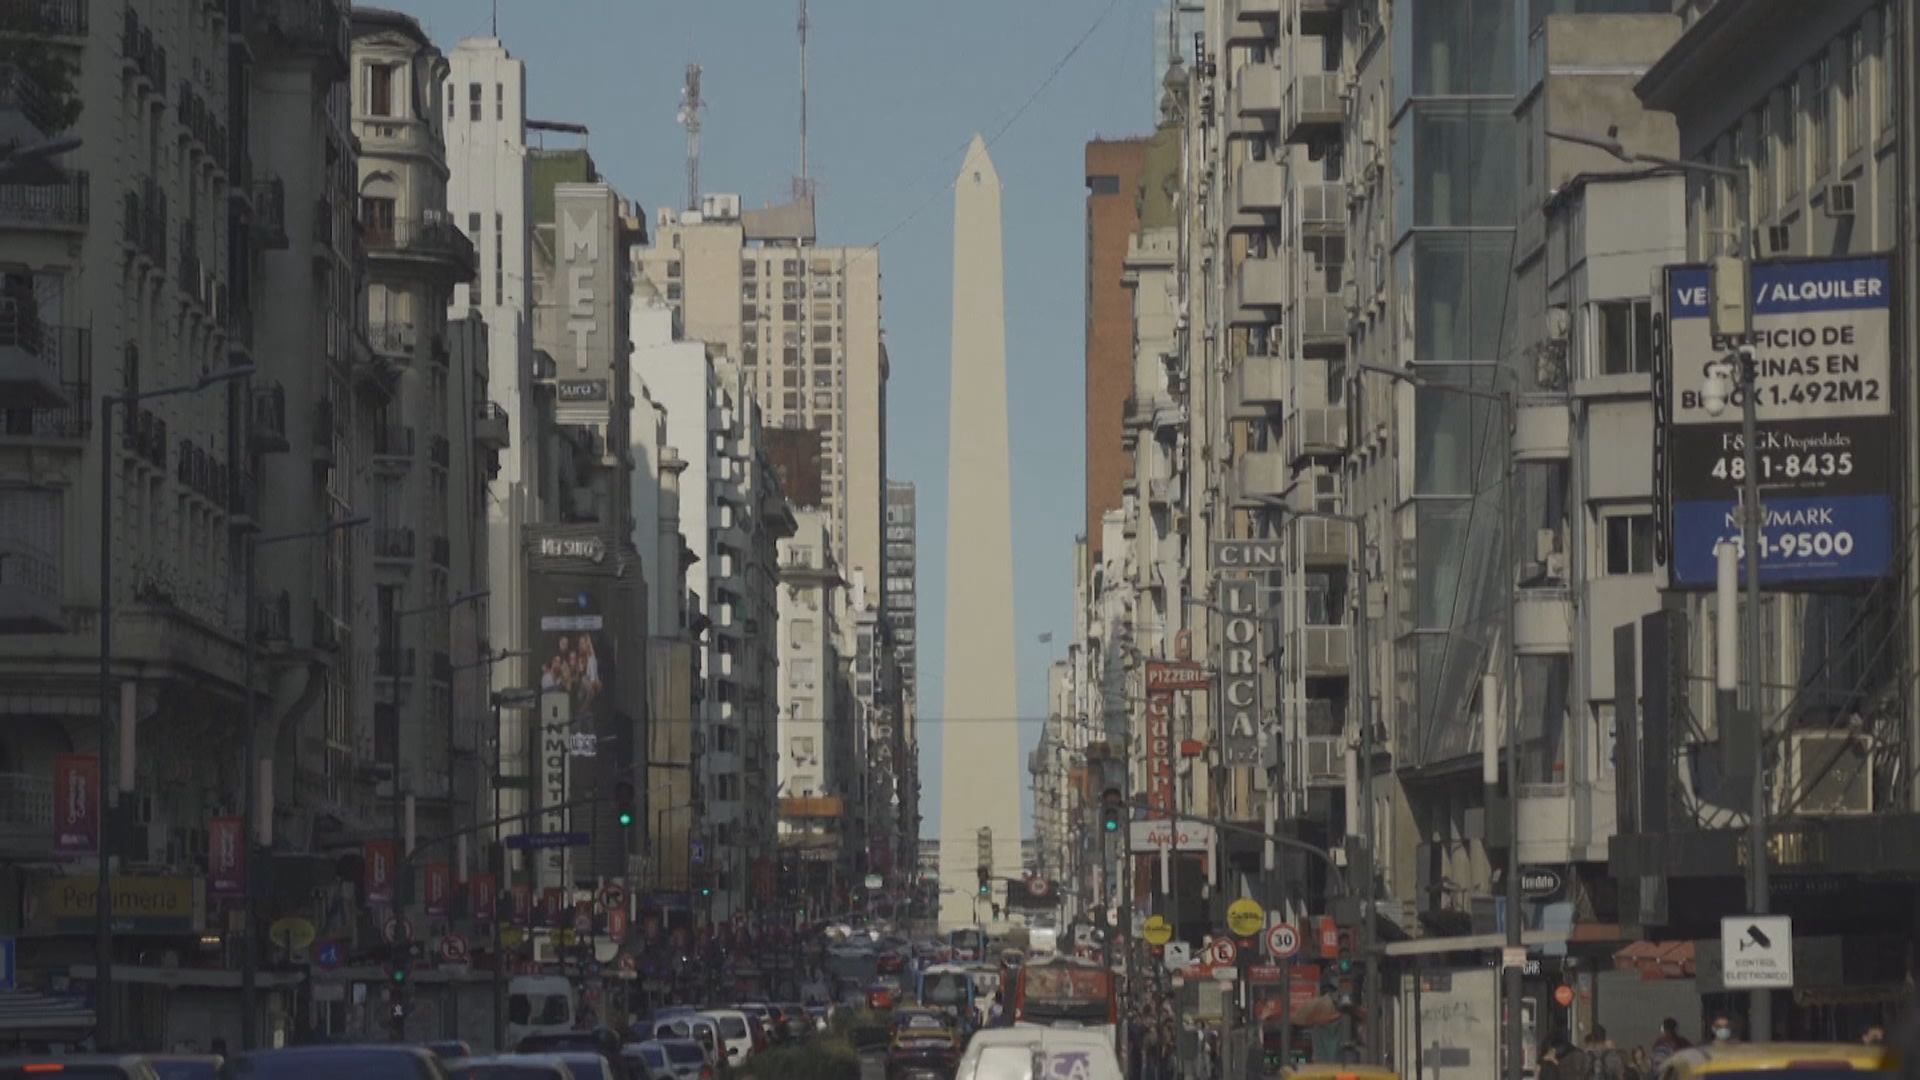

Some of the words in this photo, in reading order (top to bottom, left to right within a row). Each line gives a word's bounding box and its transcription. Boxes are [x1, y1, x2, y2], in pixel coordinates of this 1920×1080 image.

[564, 208, 598, 371] MET
[1822, 325, 1854, 346] DE
[1827, 354, 1859, 374] EN
[1770, 379, 1880, 406] 1.492M2
[1784, 430, 1850, 452] Propiedades
[1712, 453, 1853, 480] 481-8435
[1219, 546, 1284, 564] CIN
[1226, 588, 1255, 738] LORCA
[1149, 669, 1200, 684] PIZZERI
[1274, 934, 1293, 948] 30
[1735, 959, 1776, 968] CONTROL
